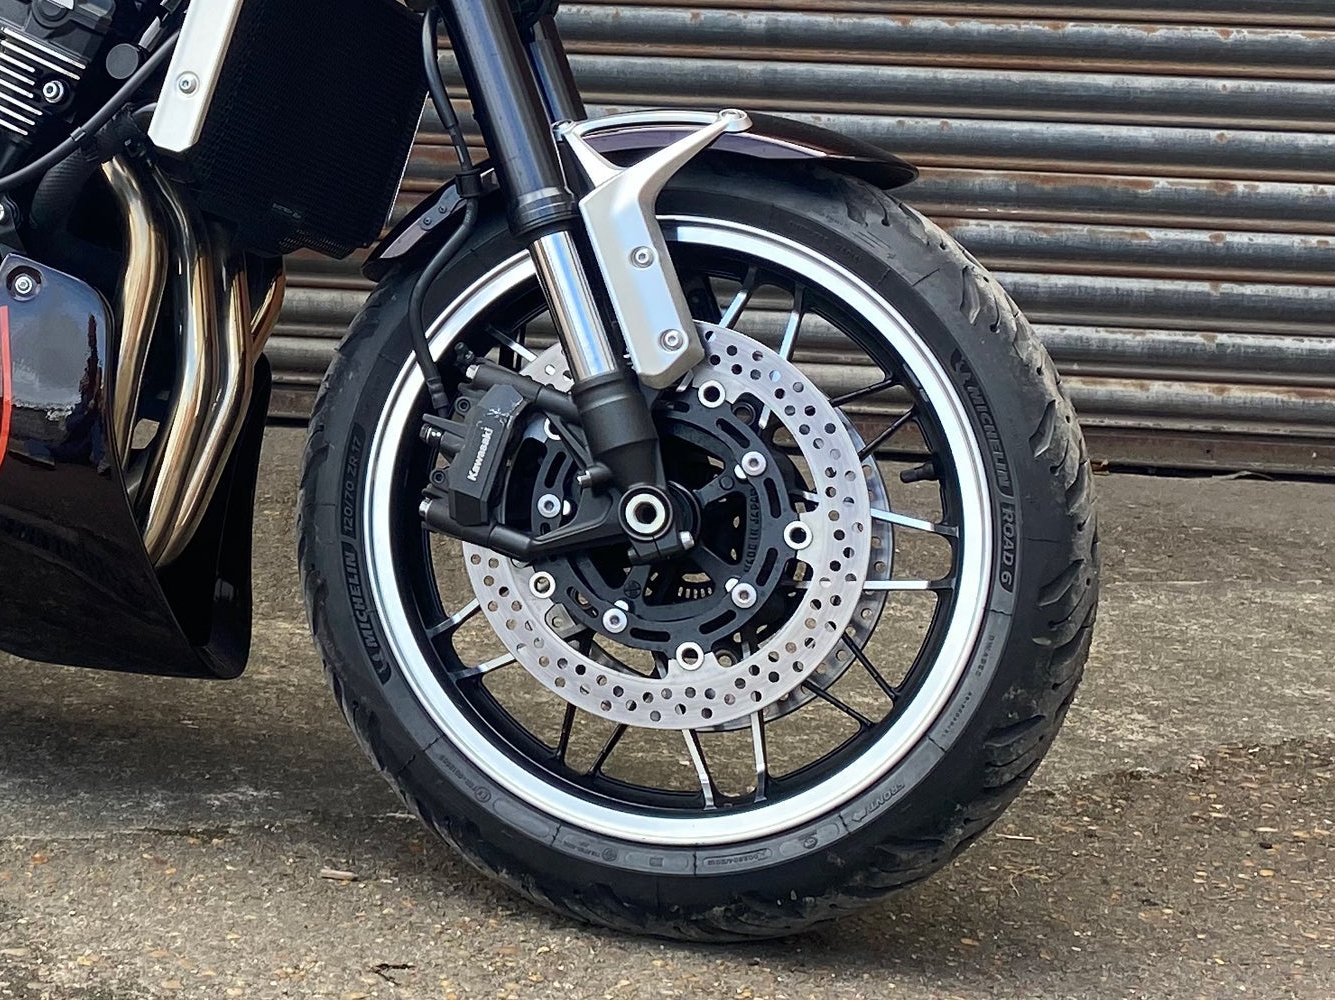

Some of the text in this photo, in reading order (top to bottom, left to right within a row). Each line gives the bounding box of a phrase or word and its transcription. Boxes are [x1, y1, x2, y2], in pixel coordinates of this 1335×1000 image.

[343, 481, 355, 532] 120/70
[351, 436, 361, 453] 17
[467, 426, 494, 481] Kawasaki
[967, 385, 1014, 587] MICHELIN ROAD 6
[345, 551, 378, 648] MICHELIN
